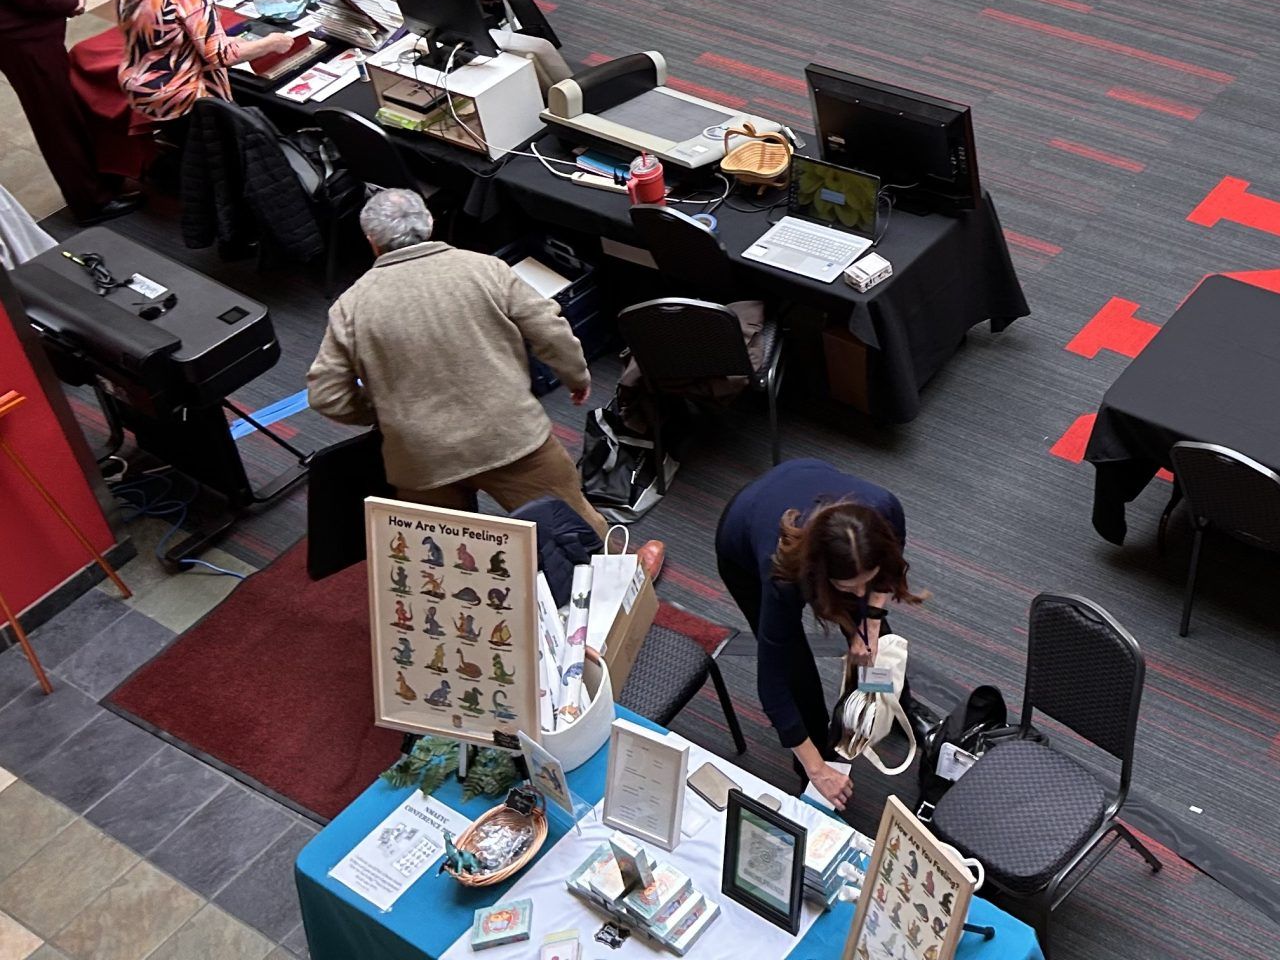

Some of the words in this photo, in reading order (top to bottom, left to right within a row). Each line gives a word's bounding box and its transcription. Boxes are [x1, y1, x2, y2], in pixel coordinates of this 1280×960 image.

[388, 515, 413, 529] How
[415, 520, 436, 533] Are
[438, 523, 460, 536] You
[462, 527, 509, 546] Feeling?
[404, 804, 442, 830] CONFERENCE
[894, 820, 908, 837] How
[908, 835, 920, 851] Are
[921, 846, 933, 864] You
[933, 860, 960, 890] Feeling?
